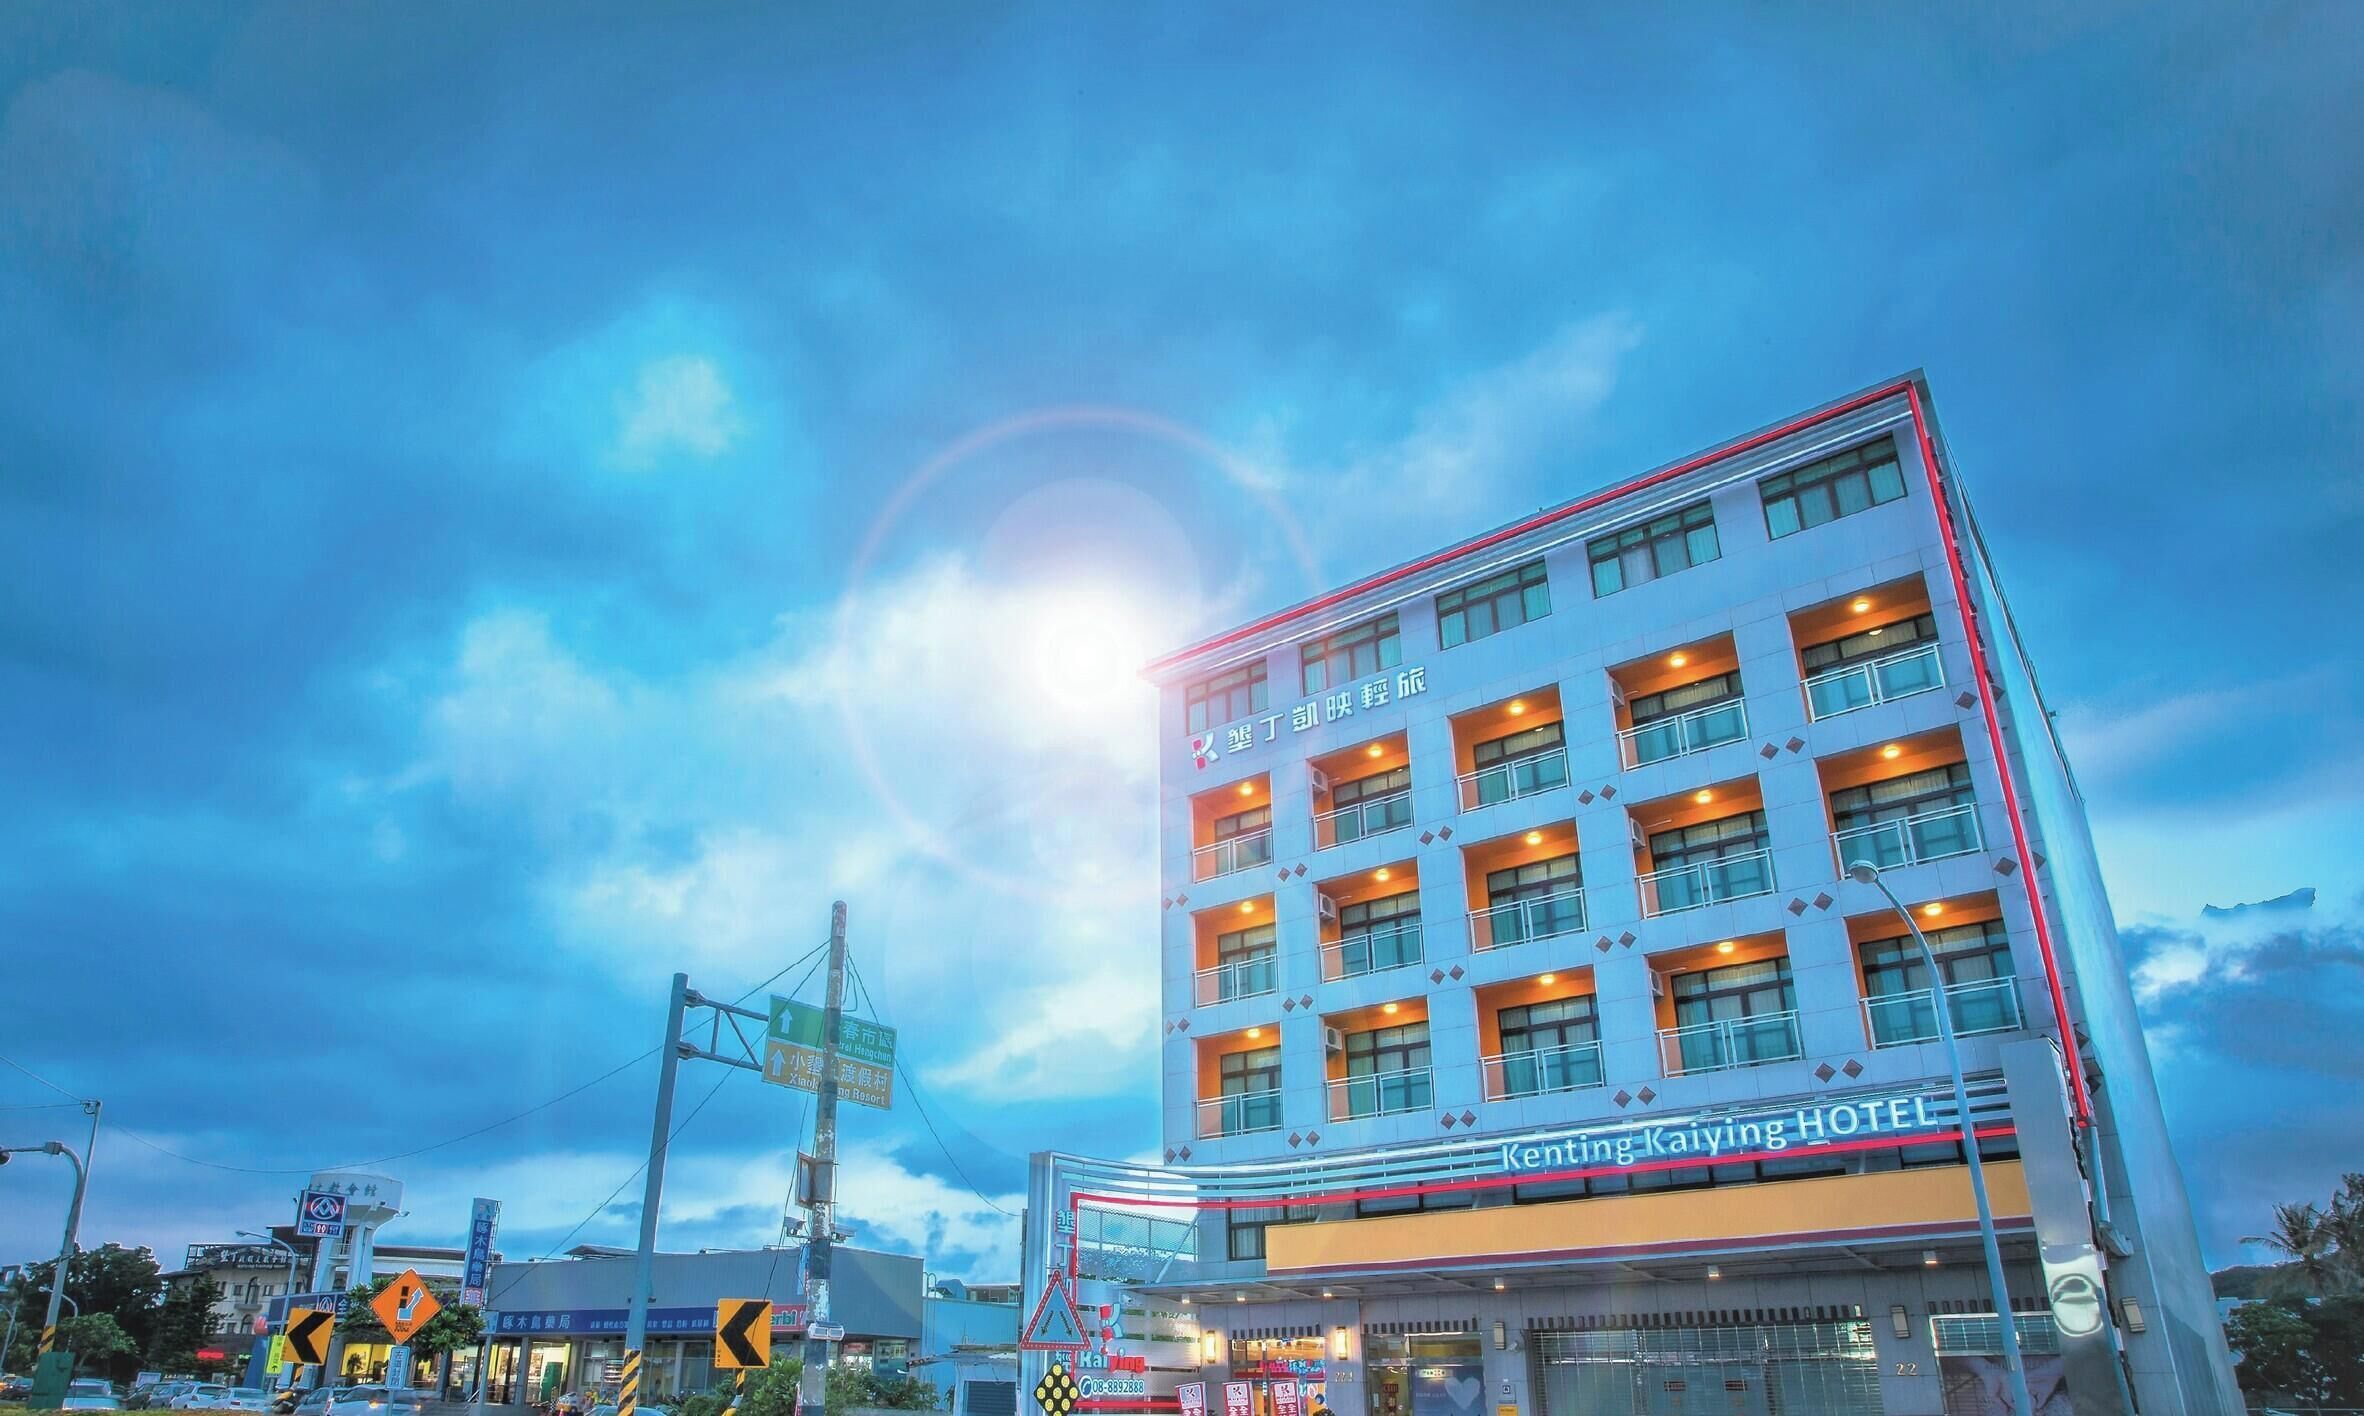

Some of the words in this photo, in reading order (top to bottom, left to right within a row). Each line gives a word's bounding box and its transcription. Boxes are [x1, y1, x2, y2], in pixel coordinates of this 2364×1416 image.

[1227, 666, 1427, 754] 墾丁凱映輕旅
[842, 1020, 893, 1049] 春市區
[790, 1051, 888, 1092] 小墾渡假村
[853, 1088, 886, 1105] Resort
[1501, 1131, 1634, 1171] Kenting
[1644, 1117, 1785, 1158] Kaiying
[1798, 1095, 1939, 1141] HOTEL
[1895, 1363, 1917, 1376] 22
[1092, 1380, 1144, 1395] 08-8892888
